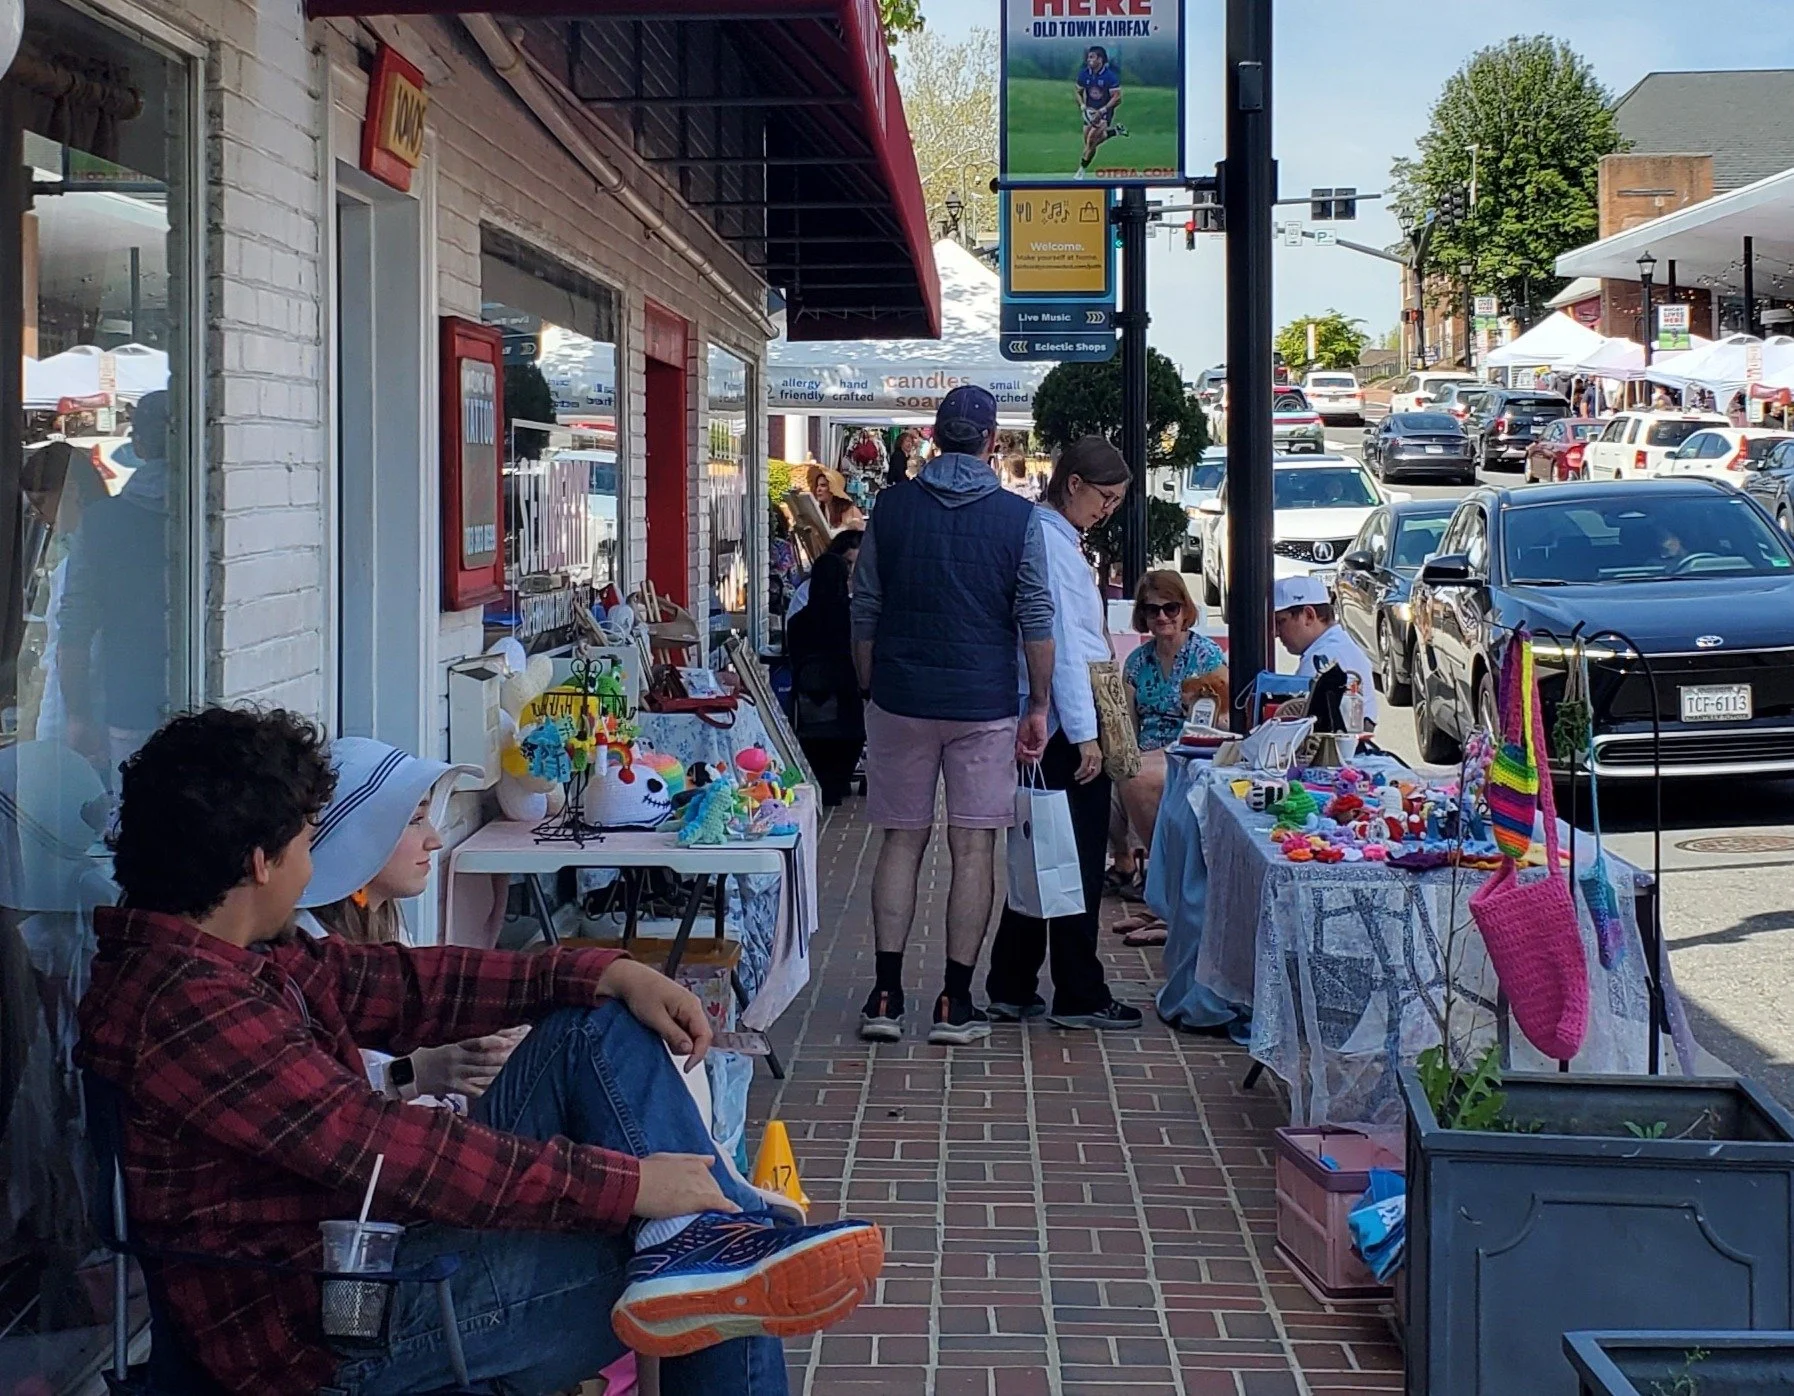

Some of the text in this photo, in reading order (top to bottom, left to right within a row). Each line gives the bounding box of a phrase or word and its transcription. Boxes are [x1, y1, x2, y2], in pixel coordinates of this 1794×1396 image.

[1033, 20, 1150, 37] OLD TOWN FAIRFAX
[1030, 241, 1085, 251] Welcome.
[1038, 254, 1065, 262] yourself
[1018, 313, 1071, 322] Live Music
[1034, 342, 1106, 353] Eclectic Shops
[781, 378, 822, 389] allergy
[839, 379, 869, 390] hand
[885, 371, 971, 389] candles
[989, 380, 1021, 390] small
[780, 390, 826, 403] friendly
[832, 391, 874, 402] crafted
[996, 393, 1029, 403] tched
[772, 1165, 791, 1190] 17
